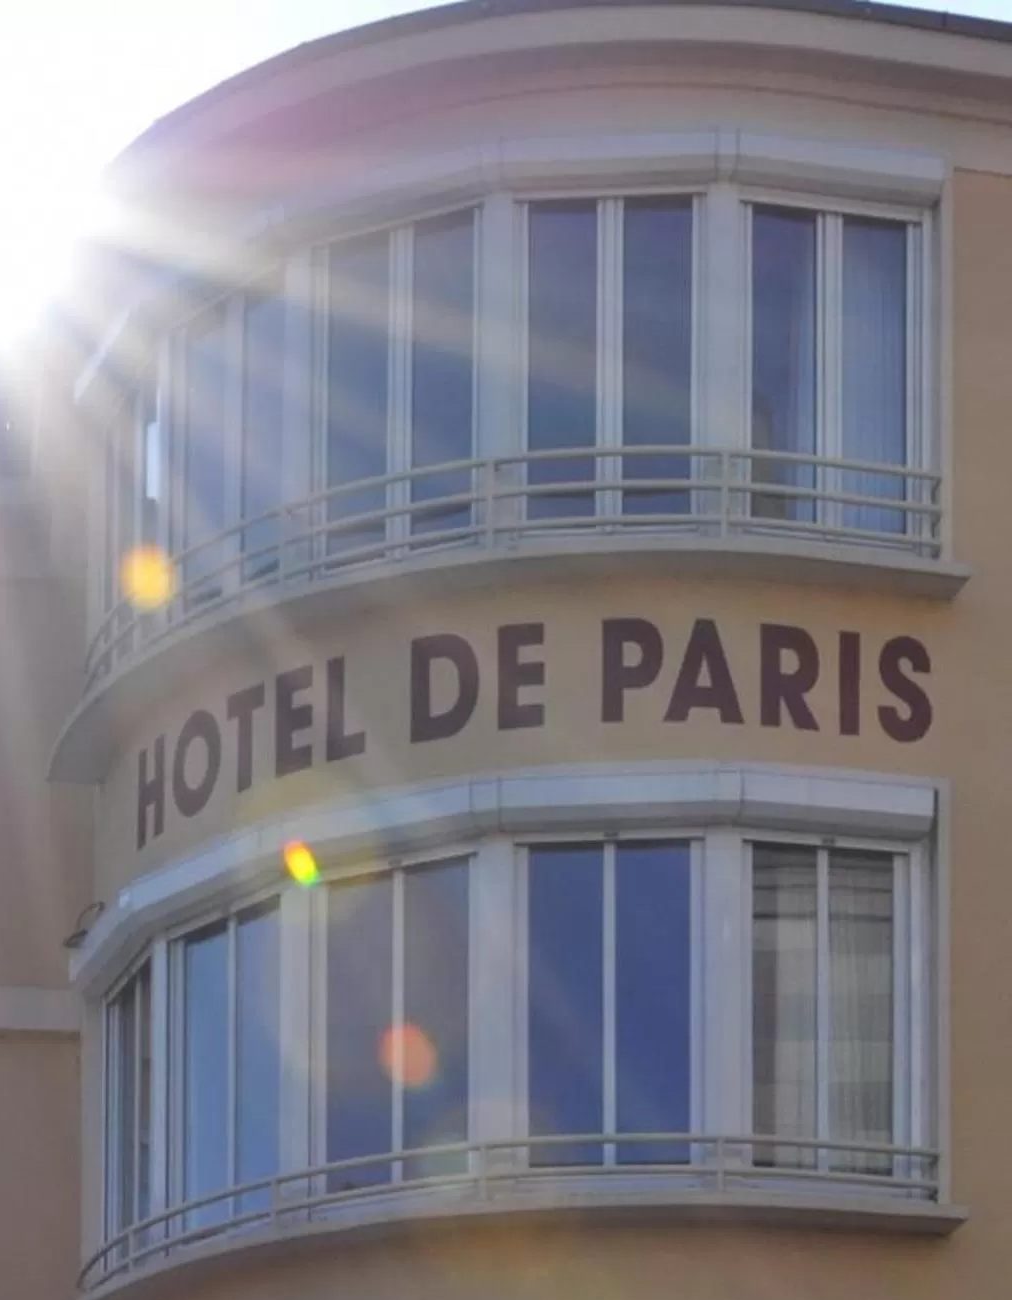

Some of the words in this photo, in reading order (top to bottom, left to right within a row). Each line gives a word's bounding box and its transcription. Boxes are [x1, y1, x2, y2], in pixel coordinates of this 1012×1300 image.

[136, 656, 366, 851] HOTEL
[410, 622, 545, 744] DE
[601, 618, 932, 743] PARIS
